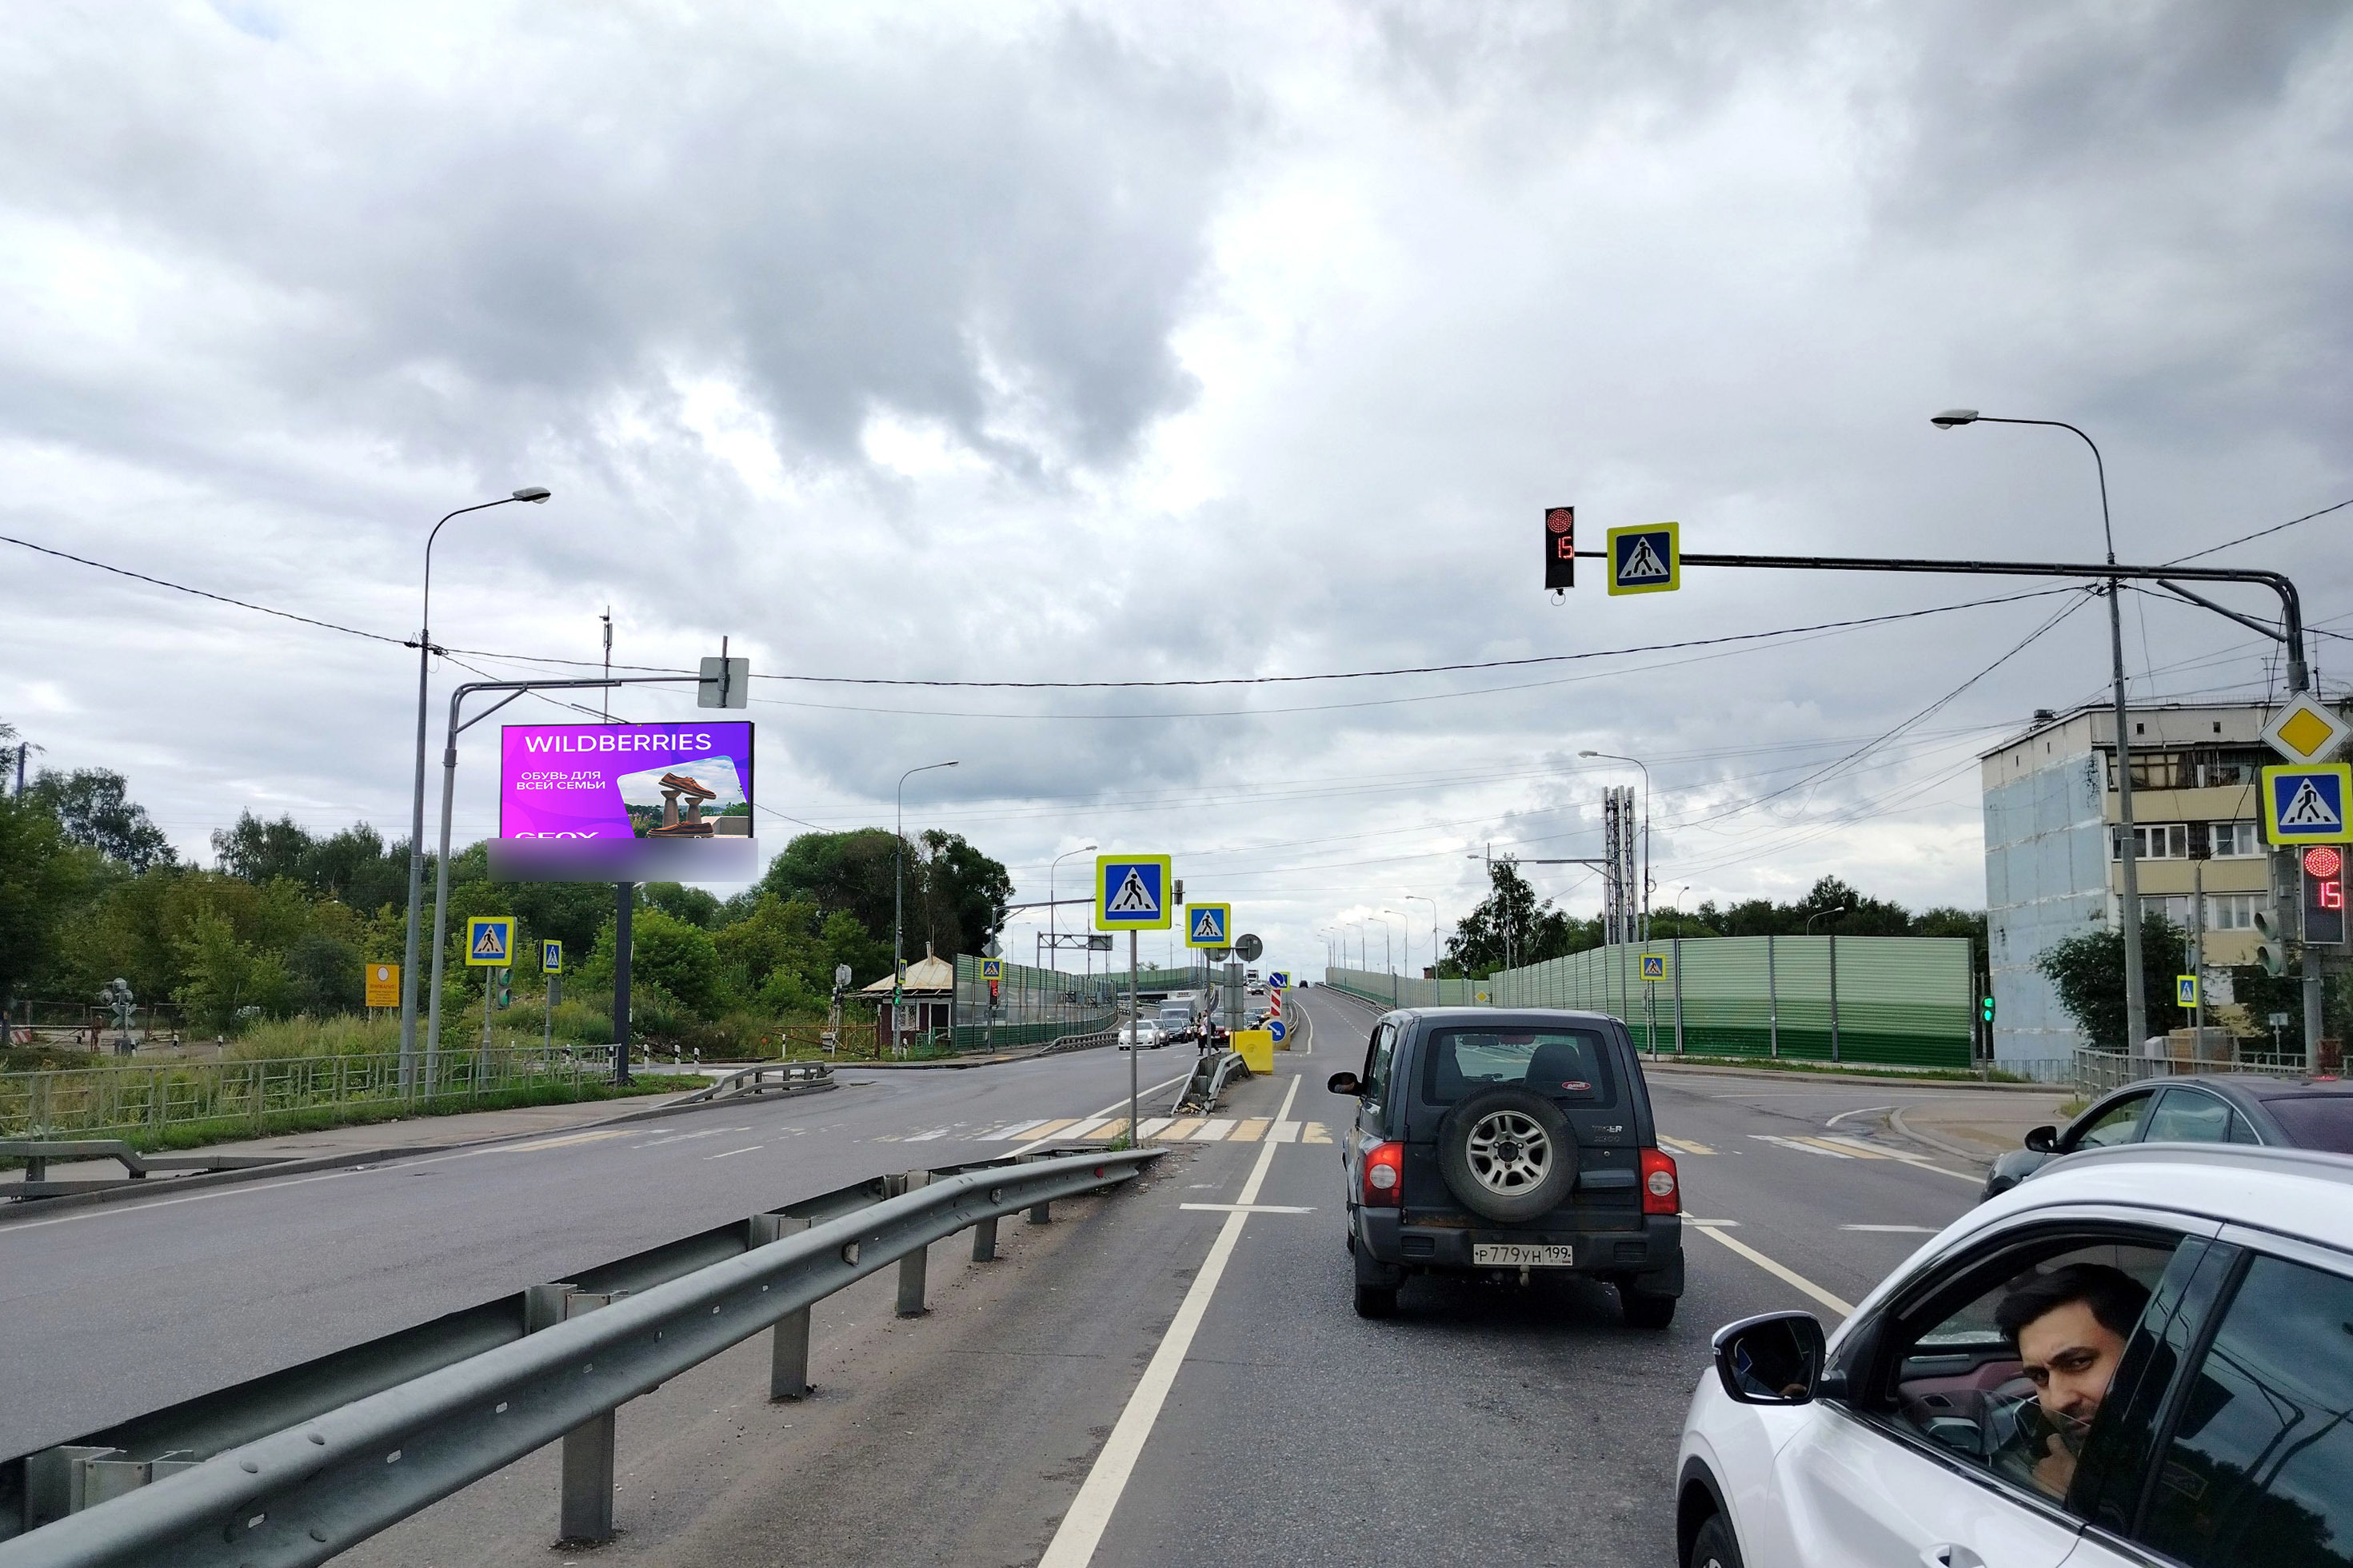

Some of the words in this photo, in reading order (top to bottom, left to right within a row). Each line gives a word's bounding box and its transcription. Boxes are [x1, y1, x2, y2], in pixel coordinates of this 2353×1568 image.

[1558, 536, 1573, 559] 15
[525, 733, 712, 752] WILDBERRIES
[521, 772, 568, 780] ОБУВЬ
[571, 771, 601, 780] ДЛЯ
[516, 780, 553, 790] ВСЕЙ
[557, 780, 605, 790] СЕМЬИ
[2320, 881, 2340, 908] 15
[1545, 1245, 1568, 1259] 199
